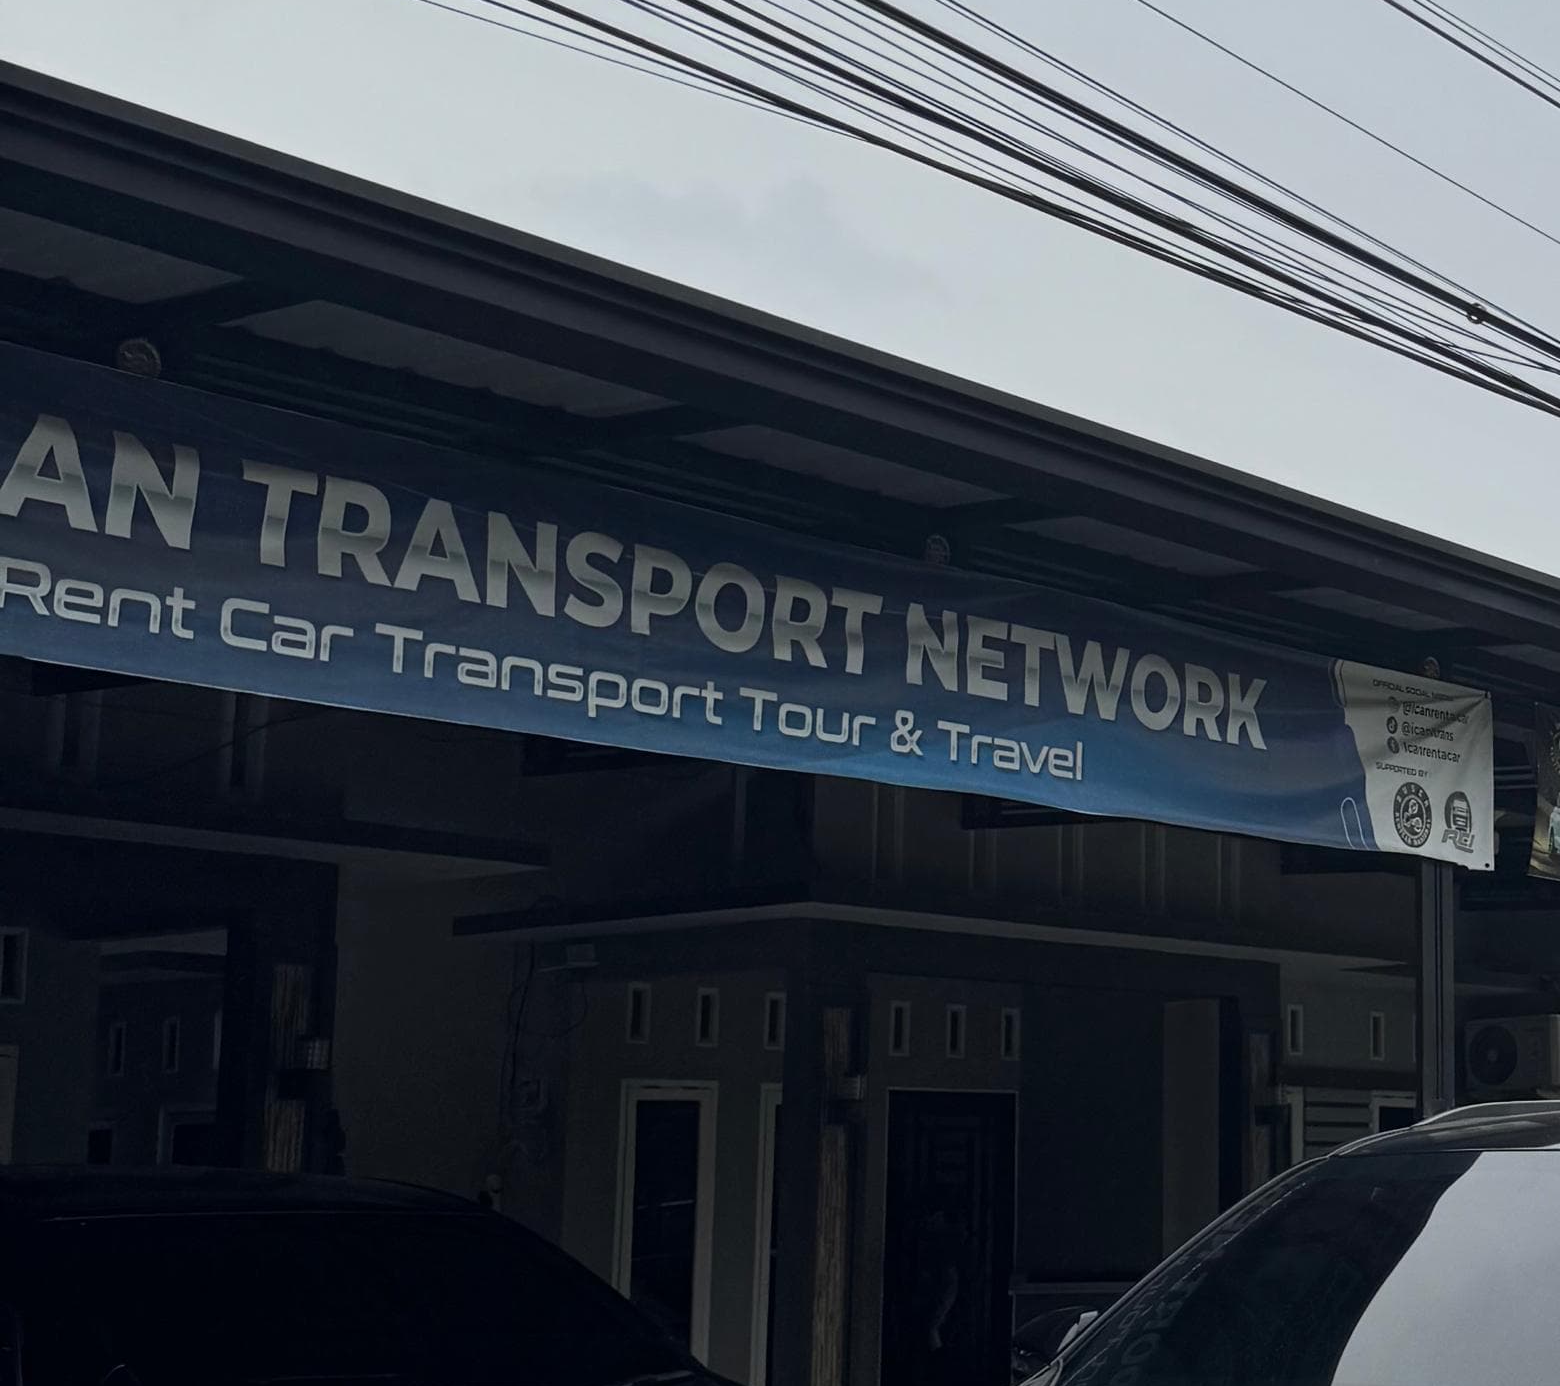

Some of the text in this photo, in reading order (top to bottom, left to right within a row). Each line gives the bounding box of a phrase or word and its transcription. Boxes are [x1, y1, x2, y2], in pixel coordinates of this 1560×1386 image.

[0, 557, 1084, 781] Rent Car Transport Tour & Travel
[242, 460, 883, 675] TRANSPORT
[906, 603, 1268, 751] NETWORK
